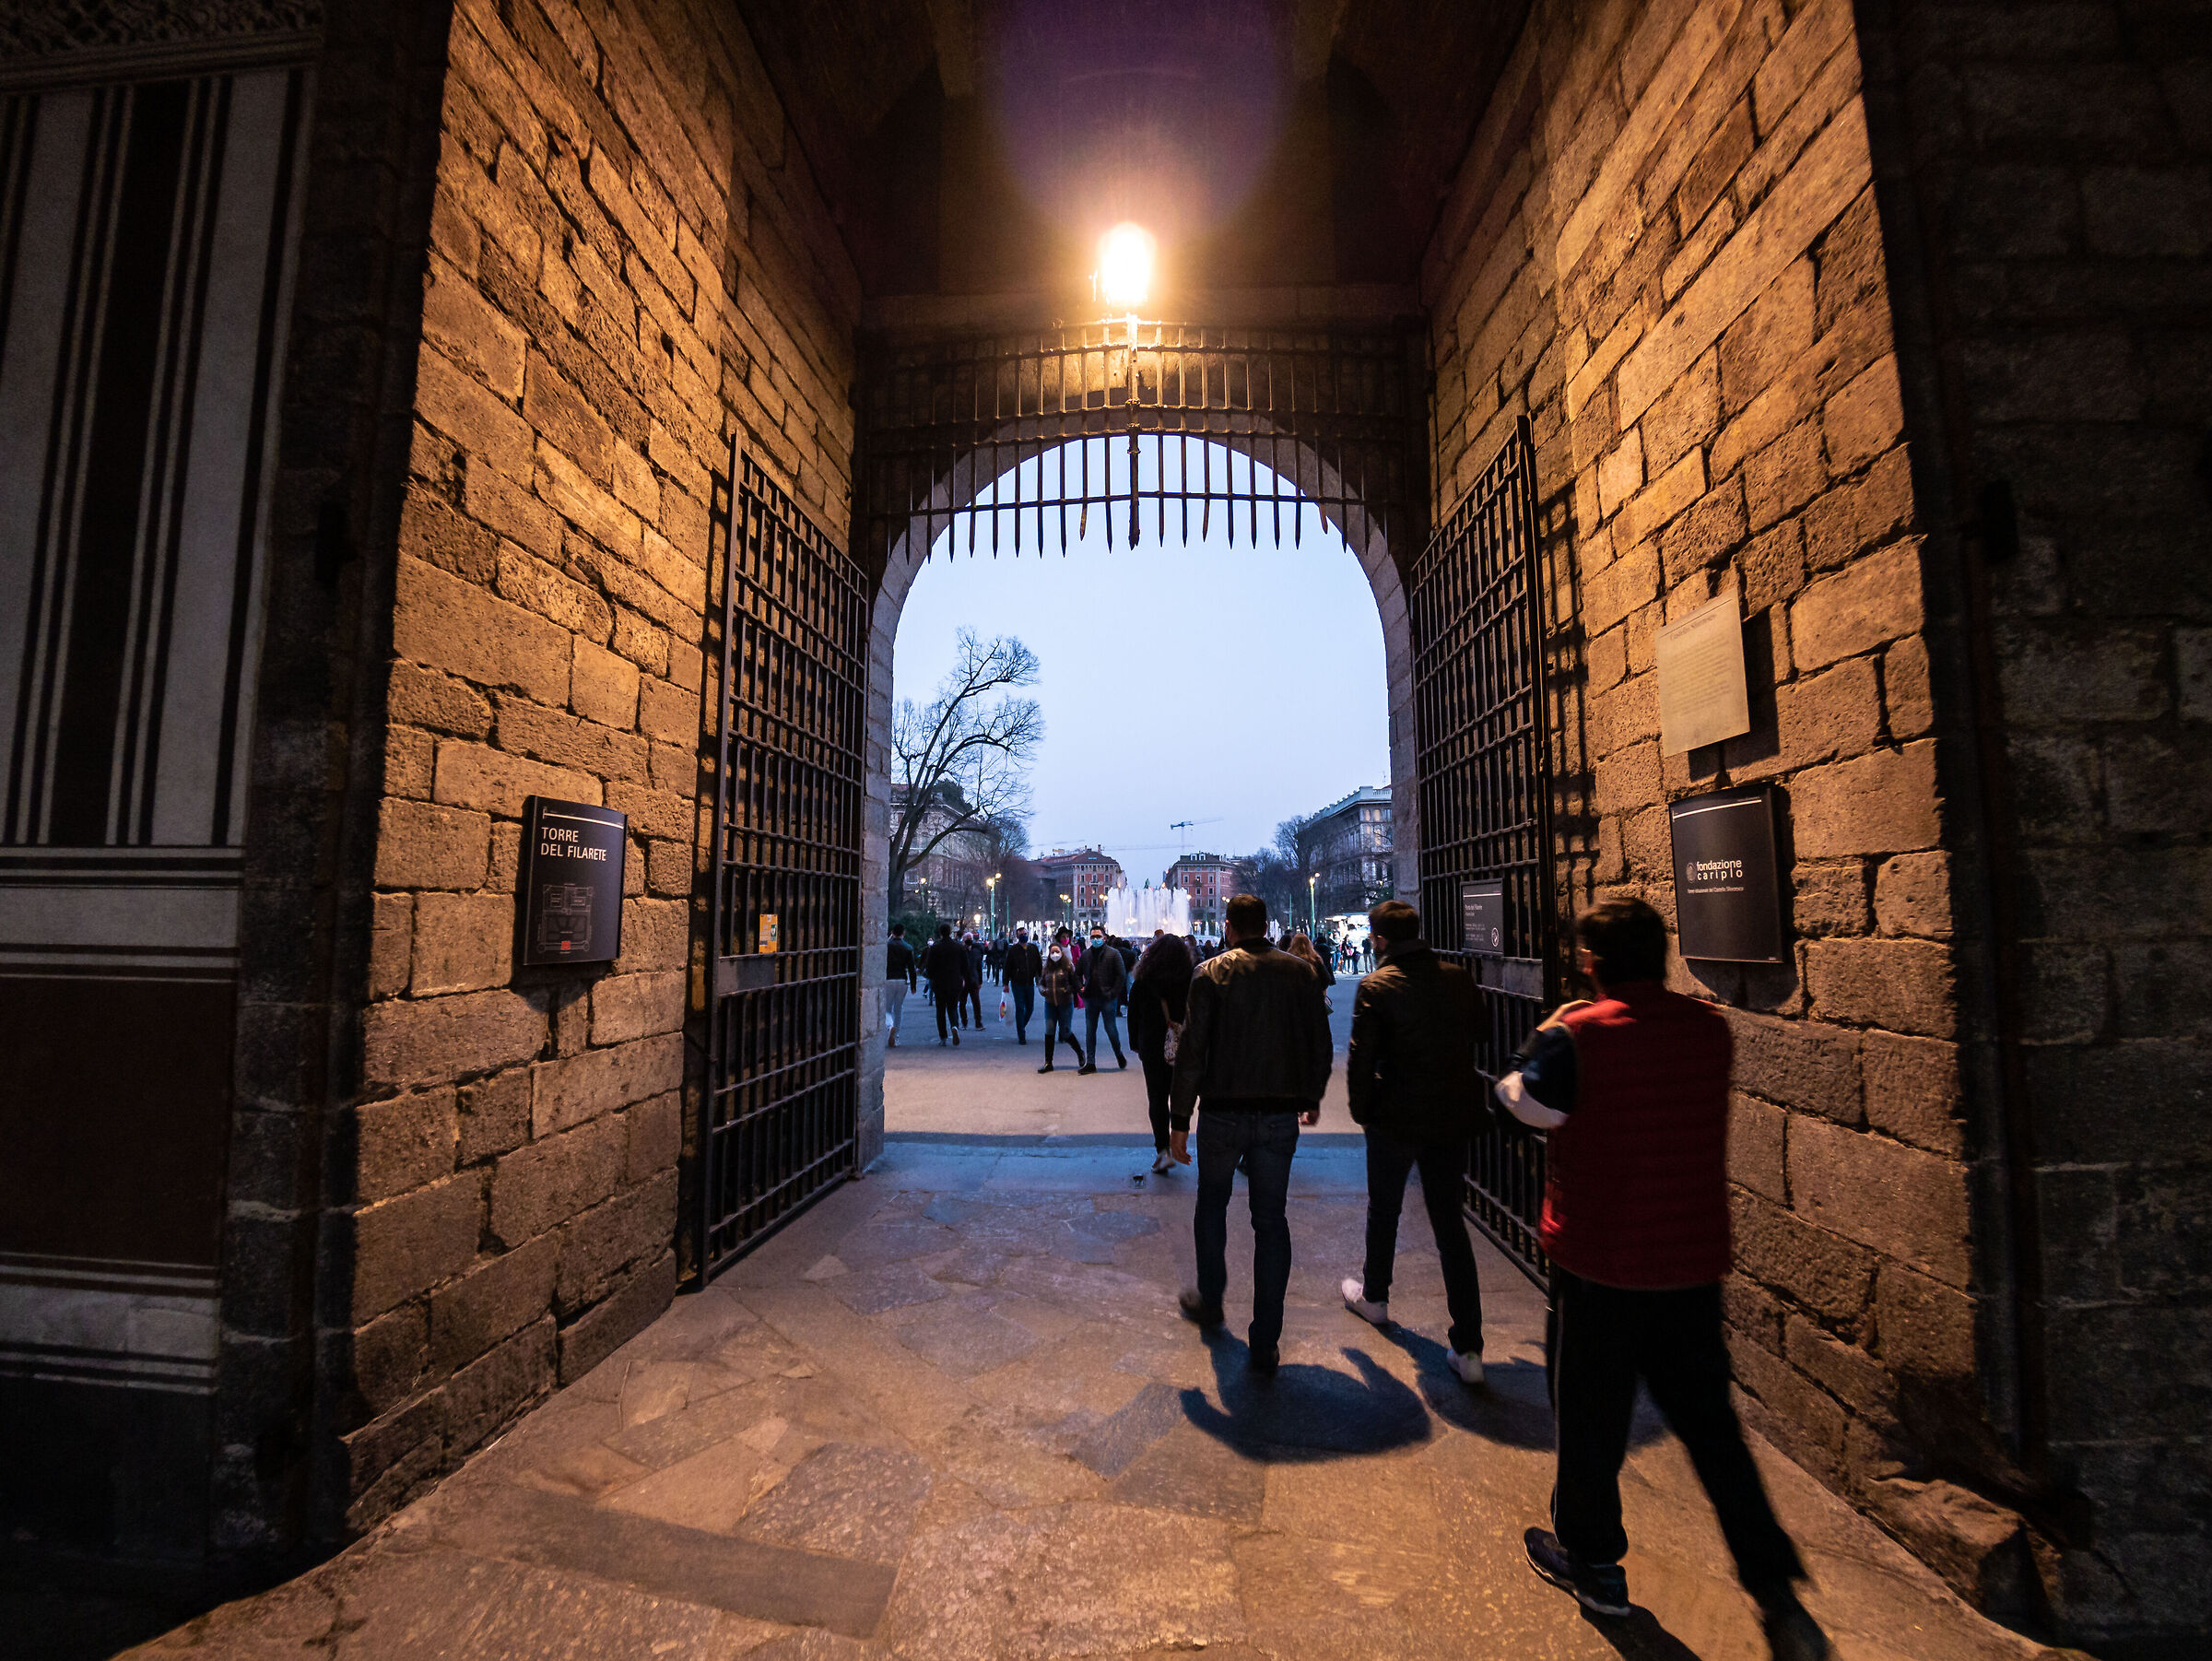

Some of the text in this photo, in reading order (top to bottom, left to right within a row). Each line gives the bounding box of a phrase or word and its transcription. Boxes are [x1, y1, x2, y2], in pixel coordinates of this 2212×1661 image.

[541, 827, 579, 842] TORRE
[540, 842, 606, 862] DEL FILARETE
[1696, 859, 1742, 872] fondazione
[1697, 867, 1743, 881] cariplo
